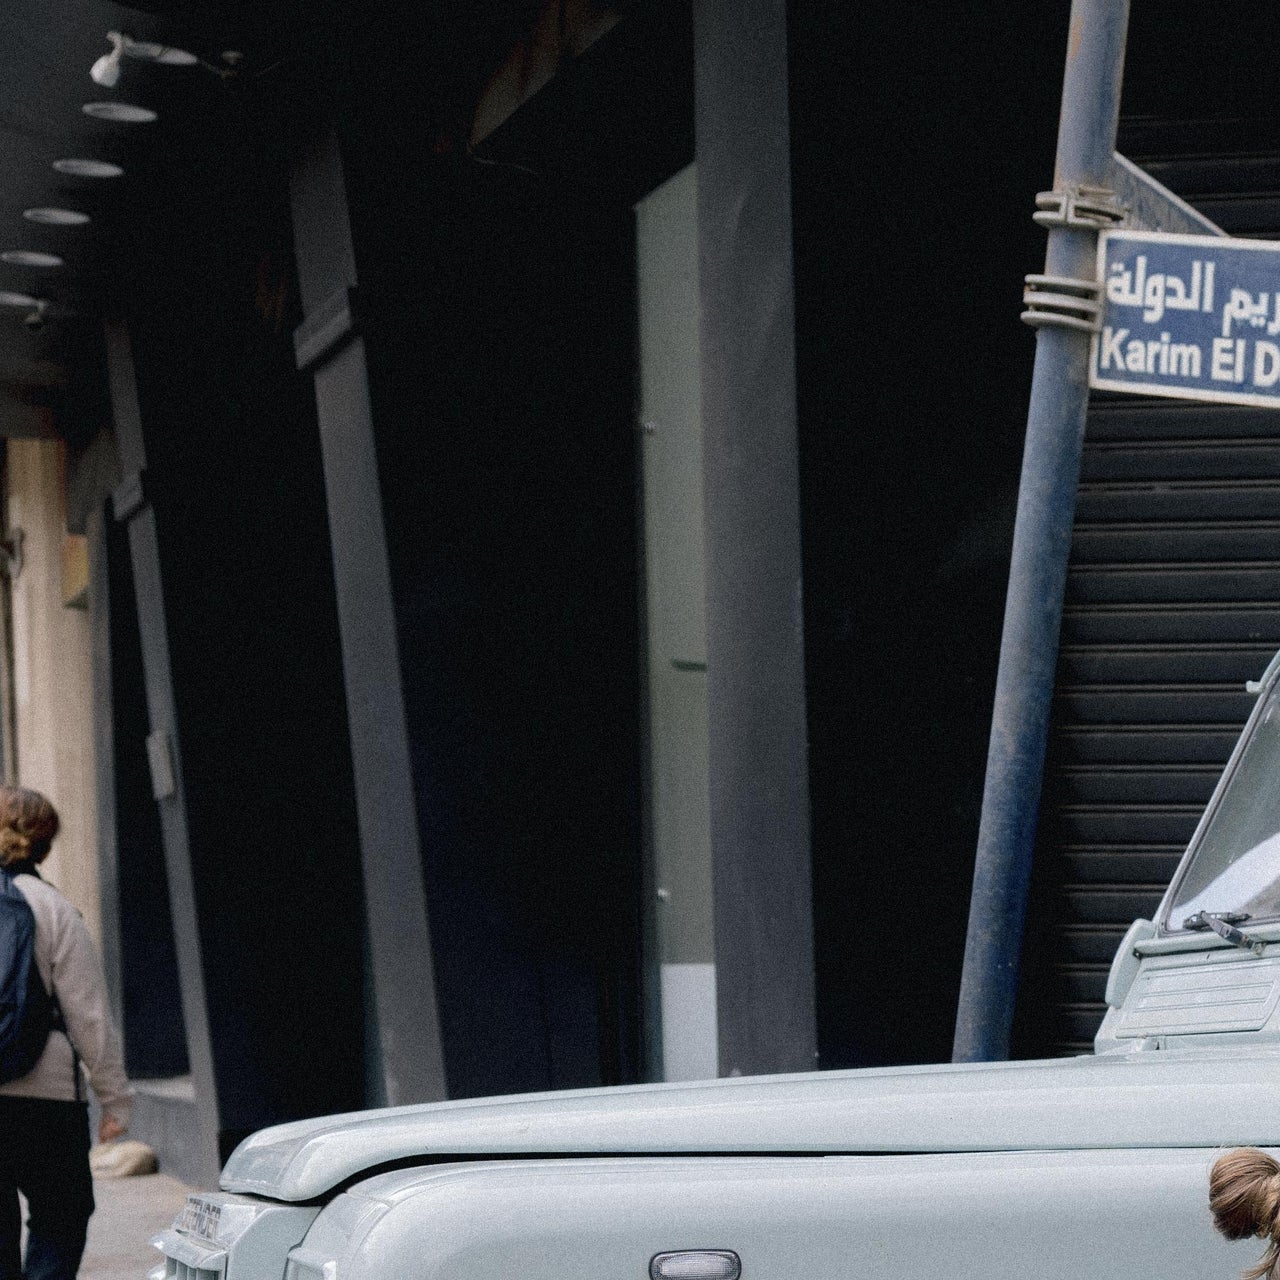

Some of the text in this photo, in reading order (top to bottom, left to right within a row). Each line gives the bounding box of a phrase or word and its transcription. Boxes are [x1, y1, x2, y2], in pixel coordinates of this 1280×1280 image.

[1106, 256, 1215, 323] الدولة
[1100, 326, 1202, 378] Karim
[1211, 337, 1246, 384] El
